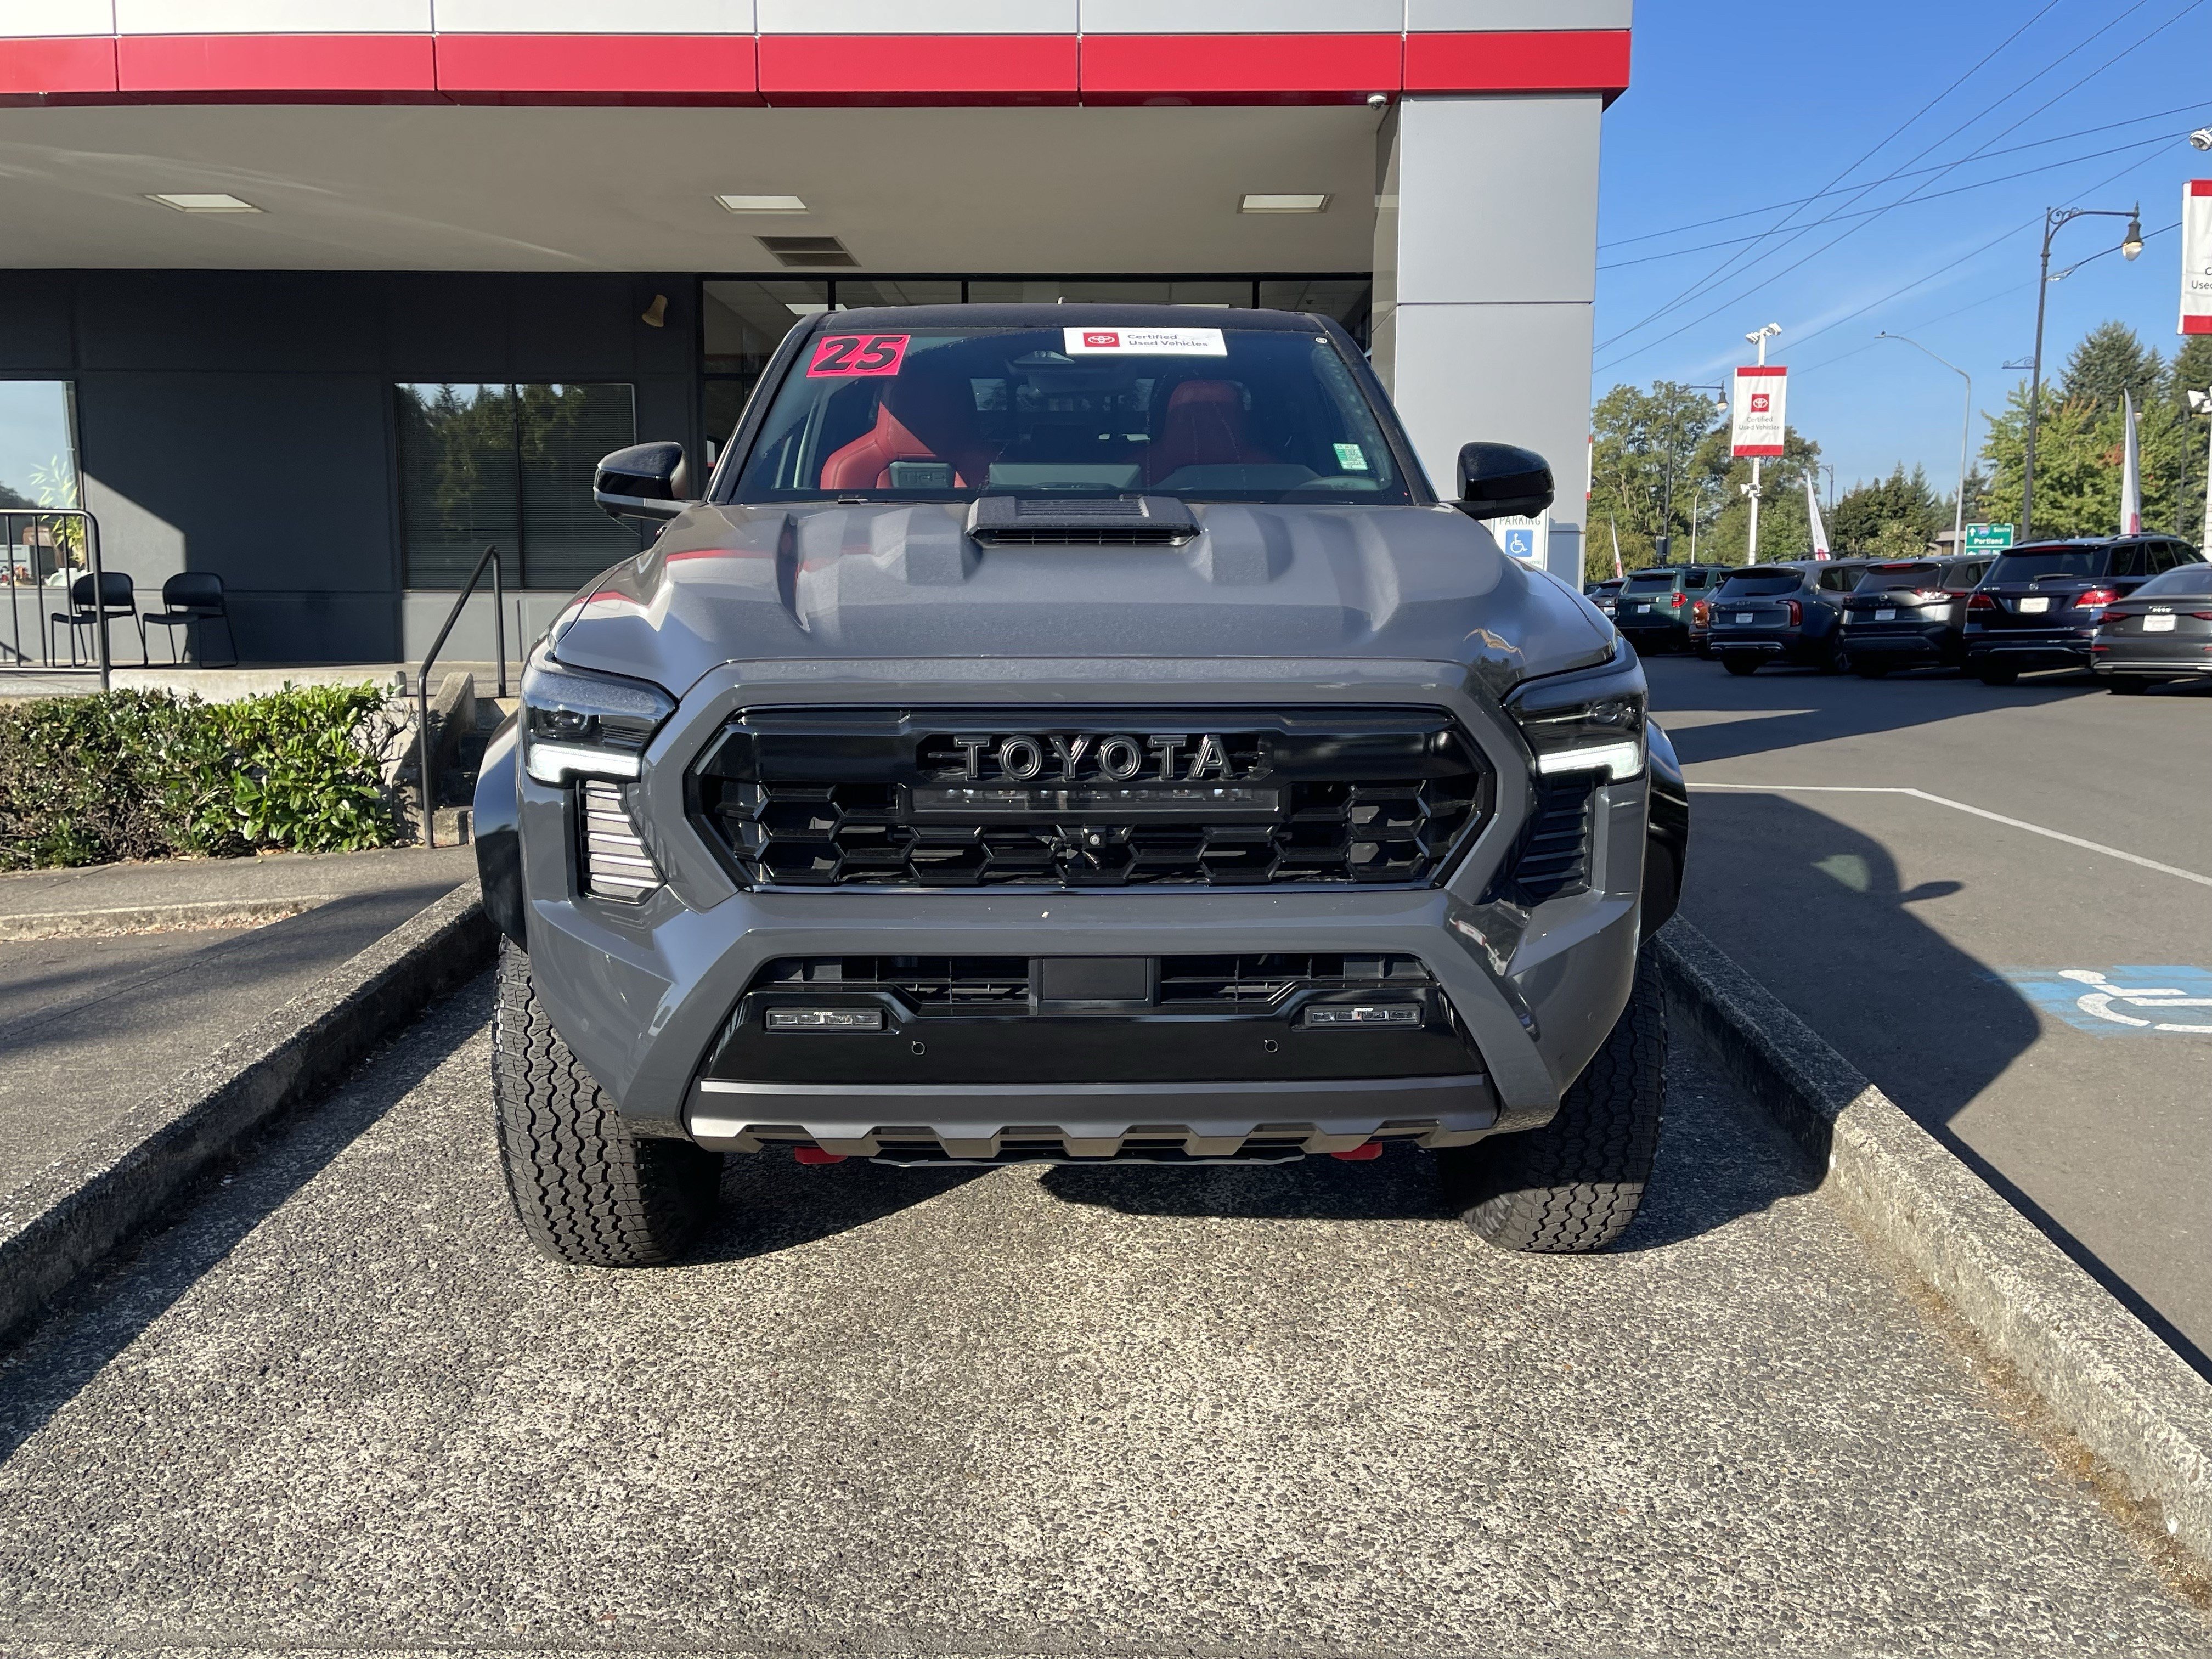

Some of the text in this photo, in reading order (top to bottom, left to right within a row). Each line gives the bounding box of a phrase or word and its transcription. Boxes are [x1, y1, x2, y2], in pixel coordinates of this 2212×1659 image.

[814, 336, 905, 372] 25
[1499, 515, 1541, 526] PARKING
[953, 734, 1234, 780] TOYOTA
